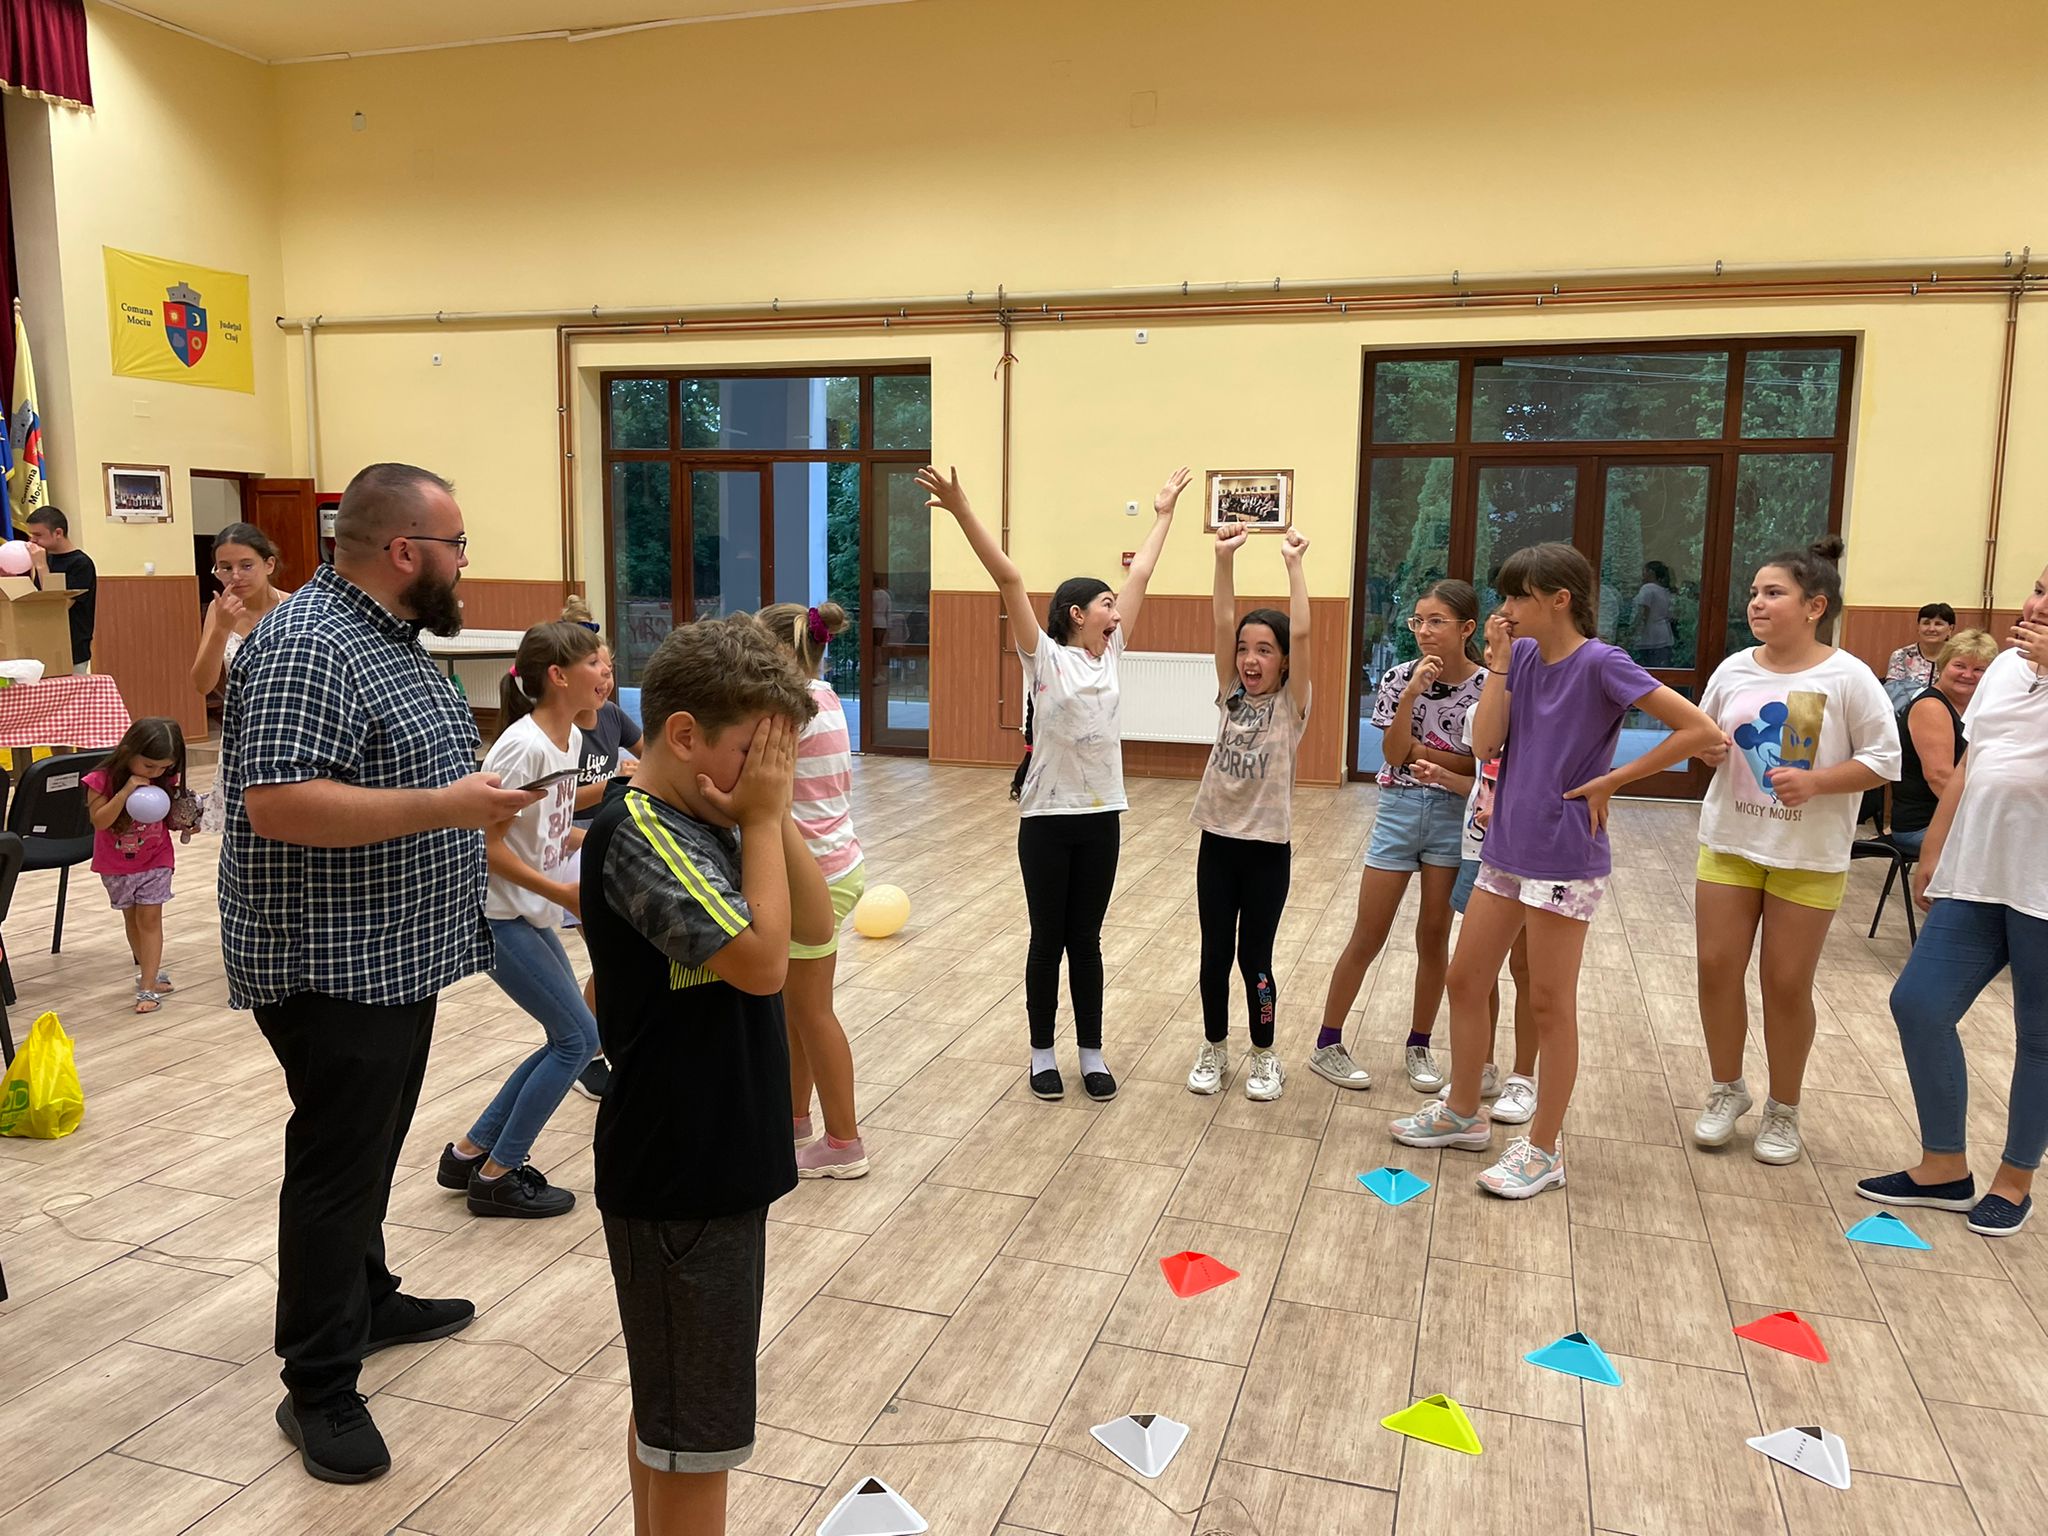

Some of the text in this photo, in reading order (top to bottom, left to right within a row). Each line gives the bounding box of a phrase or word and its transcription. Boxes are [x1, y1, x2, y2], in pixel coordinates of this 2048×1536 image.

[121, 303, 153, 315] Comuna
[127, 315, 151, 326] Mociu
[225, 333, 238, 344] Cluj
[1222, 728, 1268, 751] not
[586, 753, 609, 774] life
[579, 768, 592, 782] is
[1735, 801, 1766, 817] MICKEY
[1258, 987, 1273, 1024] LOVE
